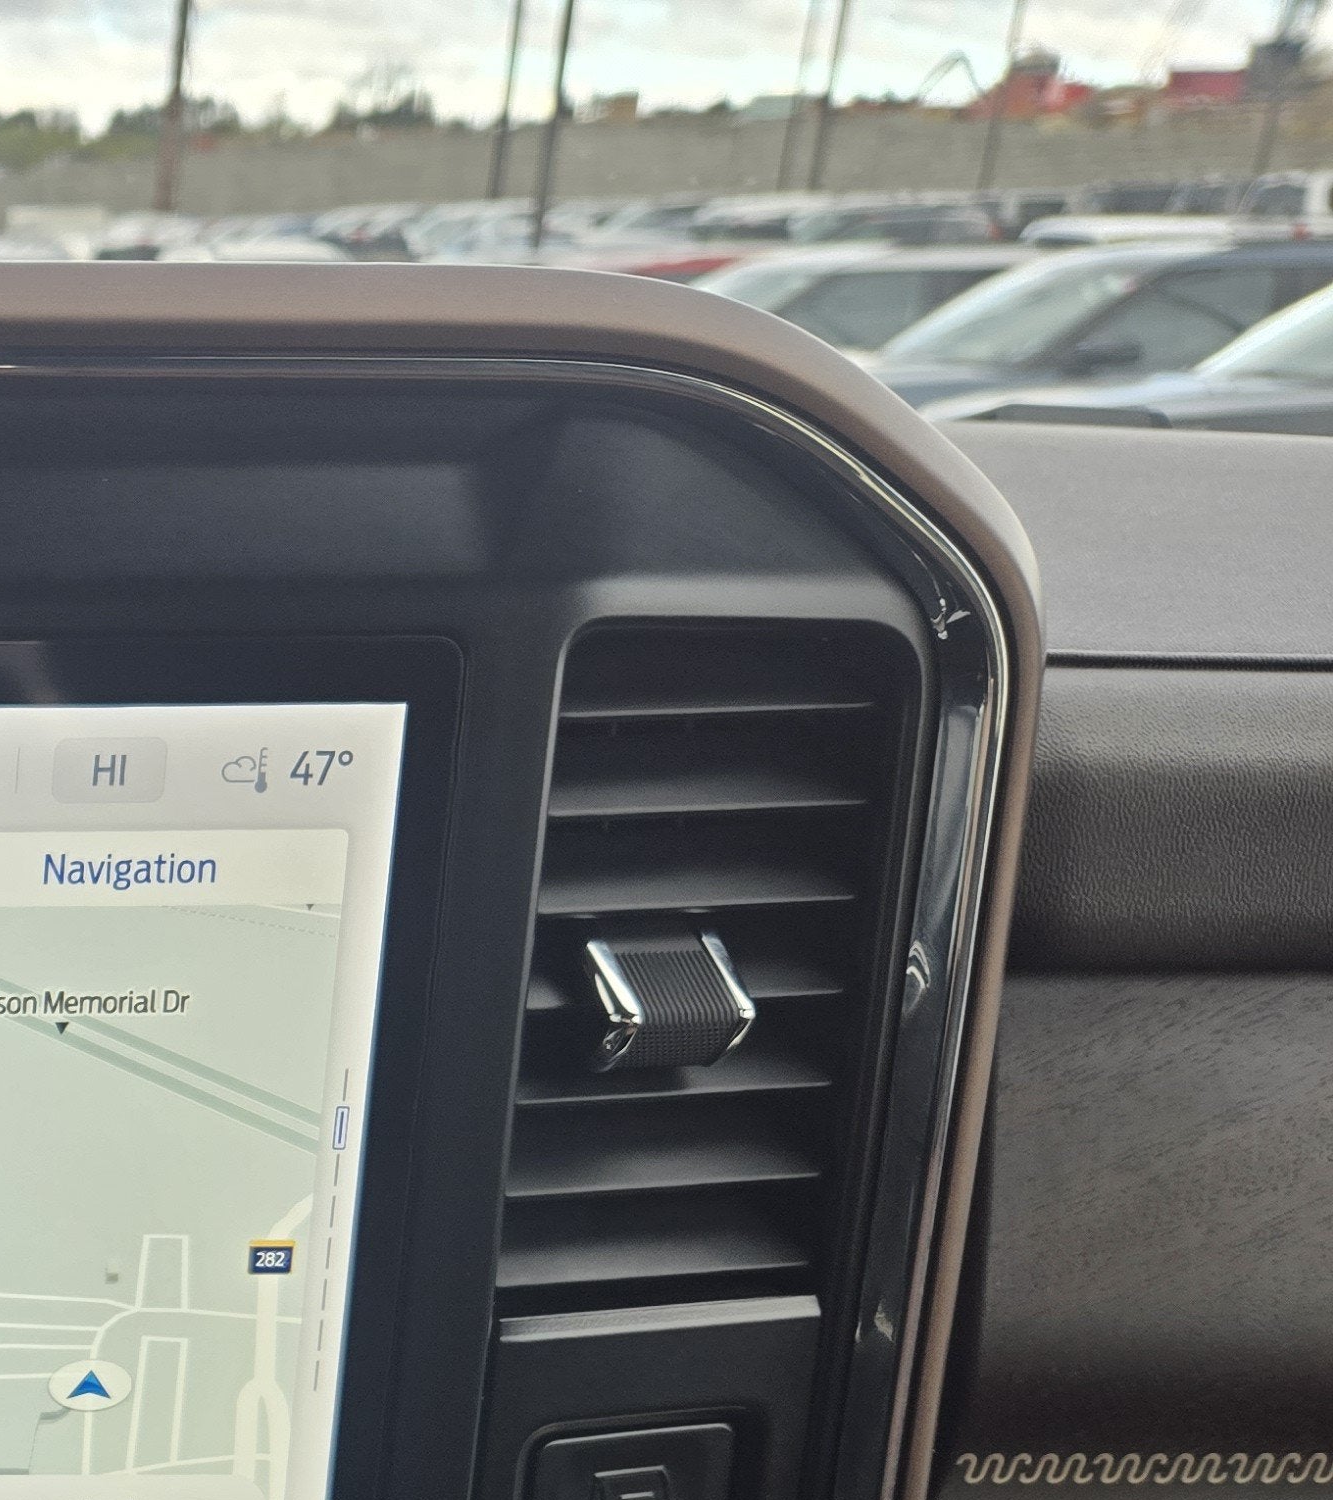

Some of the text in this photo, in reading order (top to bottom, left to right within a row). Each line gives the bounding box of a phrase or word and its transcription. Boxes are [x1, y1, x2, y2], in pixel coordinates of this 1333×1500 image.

[92, 754, 127, 786] HI
[290, 750, 353, 786] 47°
[43, 853, 216, 890] Navigation
[44, 990, 156, 1014] Memorial
[163, 990, 190, 1013] Dr
[255, 1251, 285, 1267] 282
